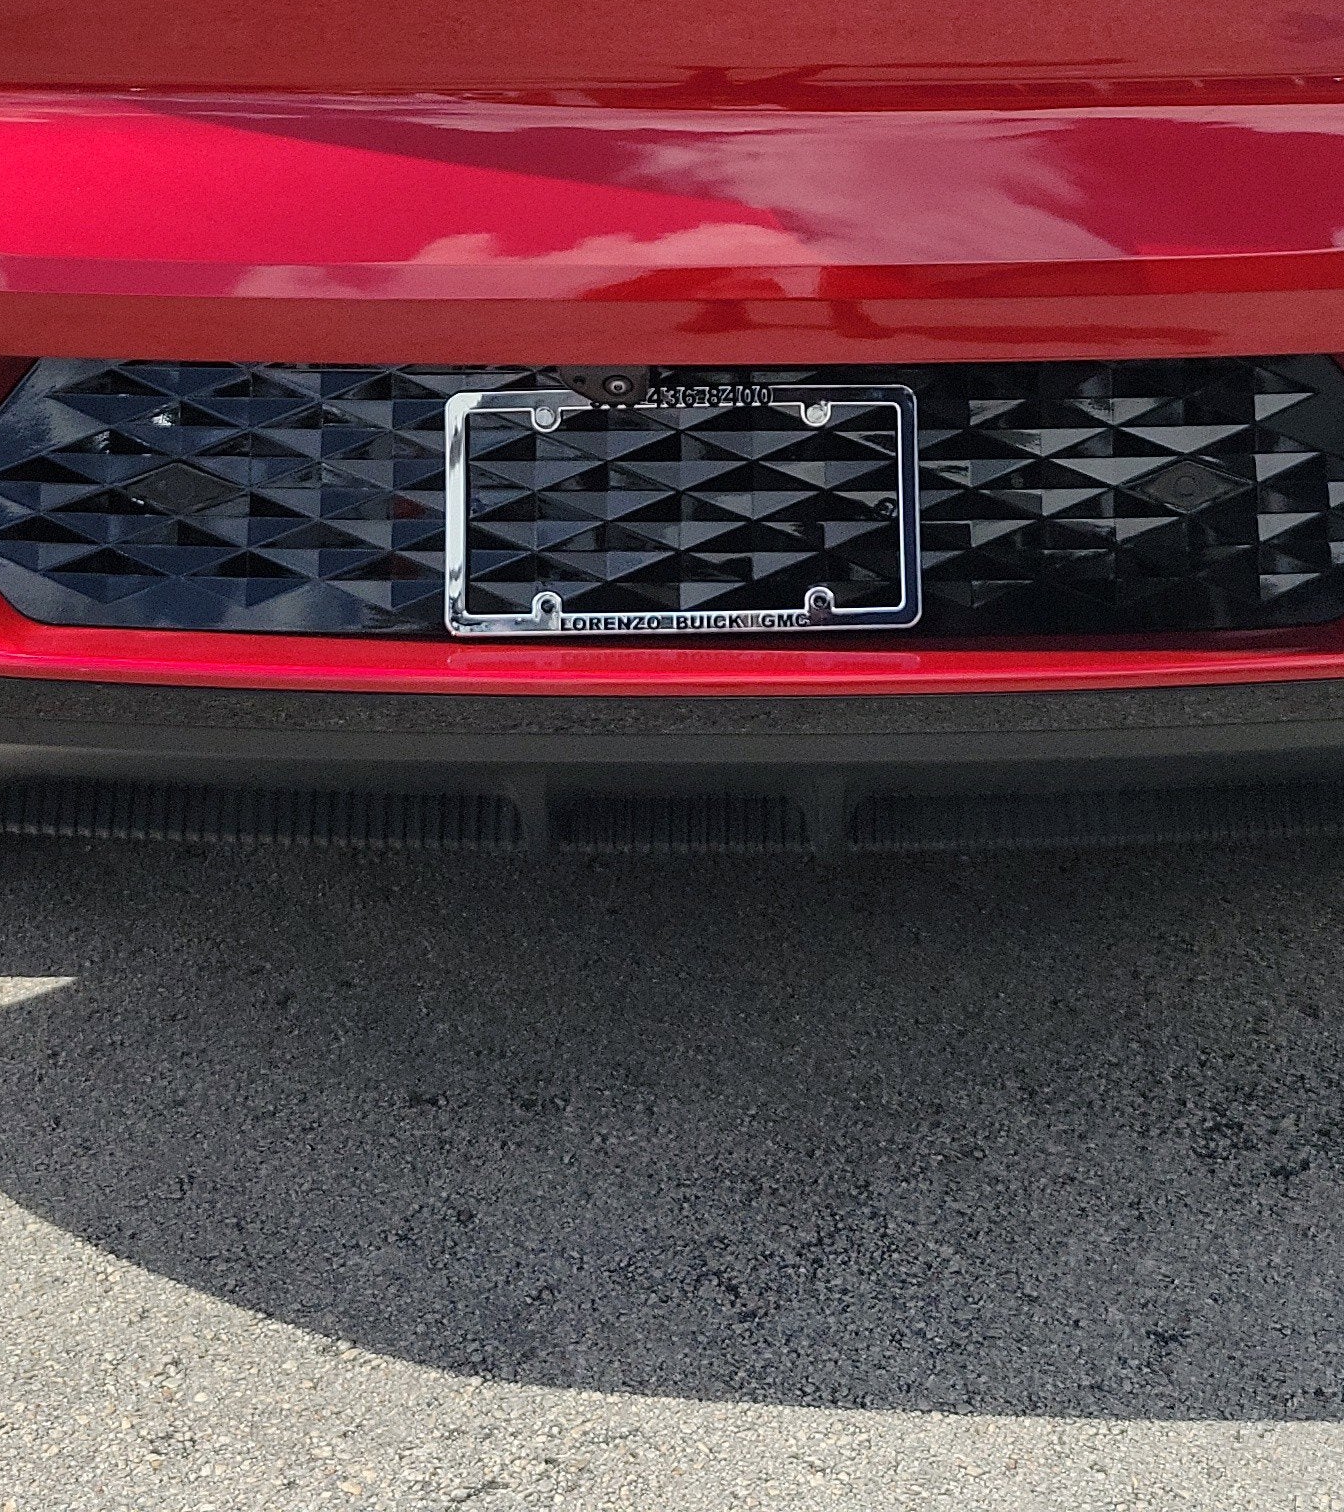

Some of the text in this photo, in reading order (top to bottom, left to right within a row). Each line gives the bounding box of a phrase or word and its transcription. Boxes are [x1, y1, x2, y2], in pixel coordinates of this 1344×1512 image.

[559, 613, 811, 632] LORENZO BUICK GMC
